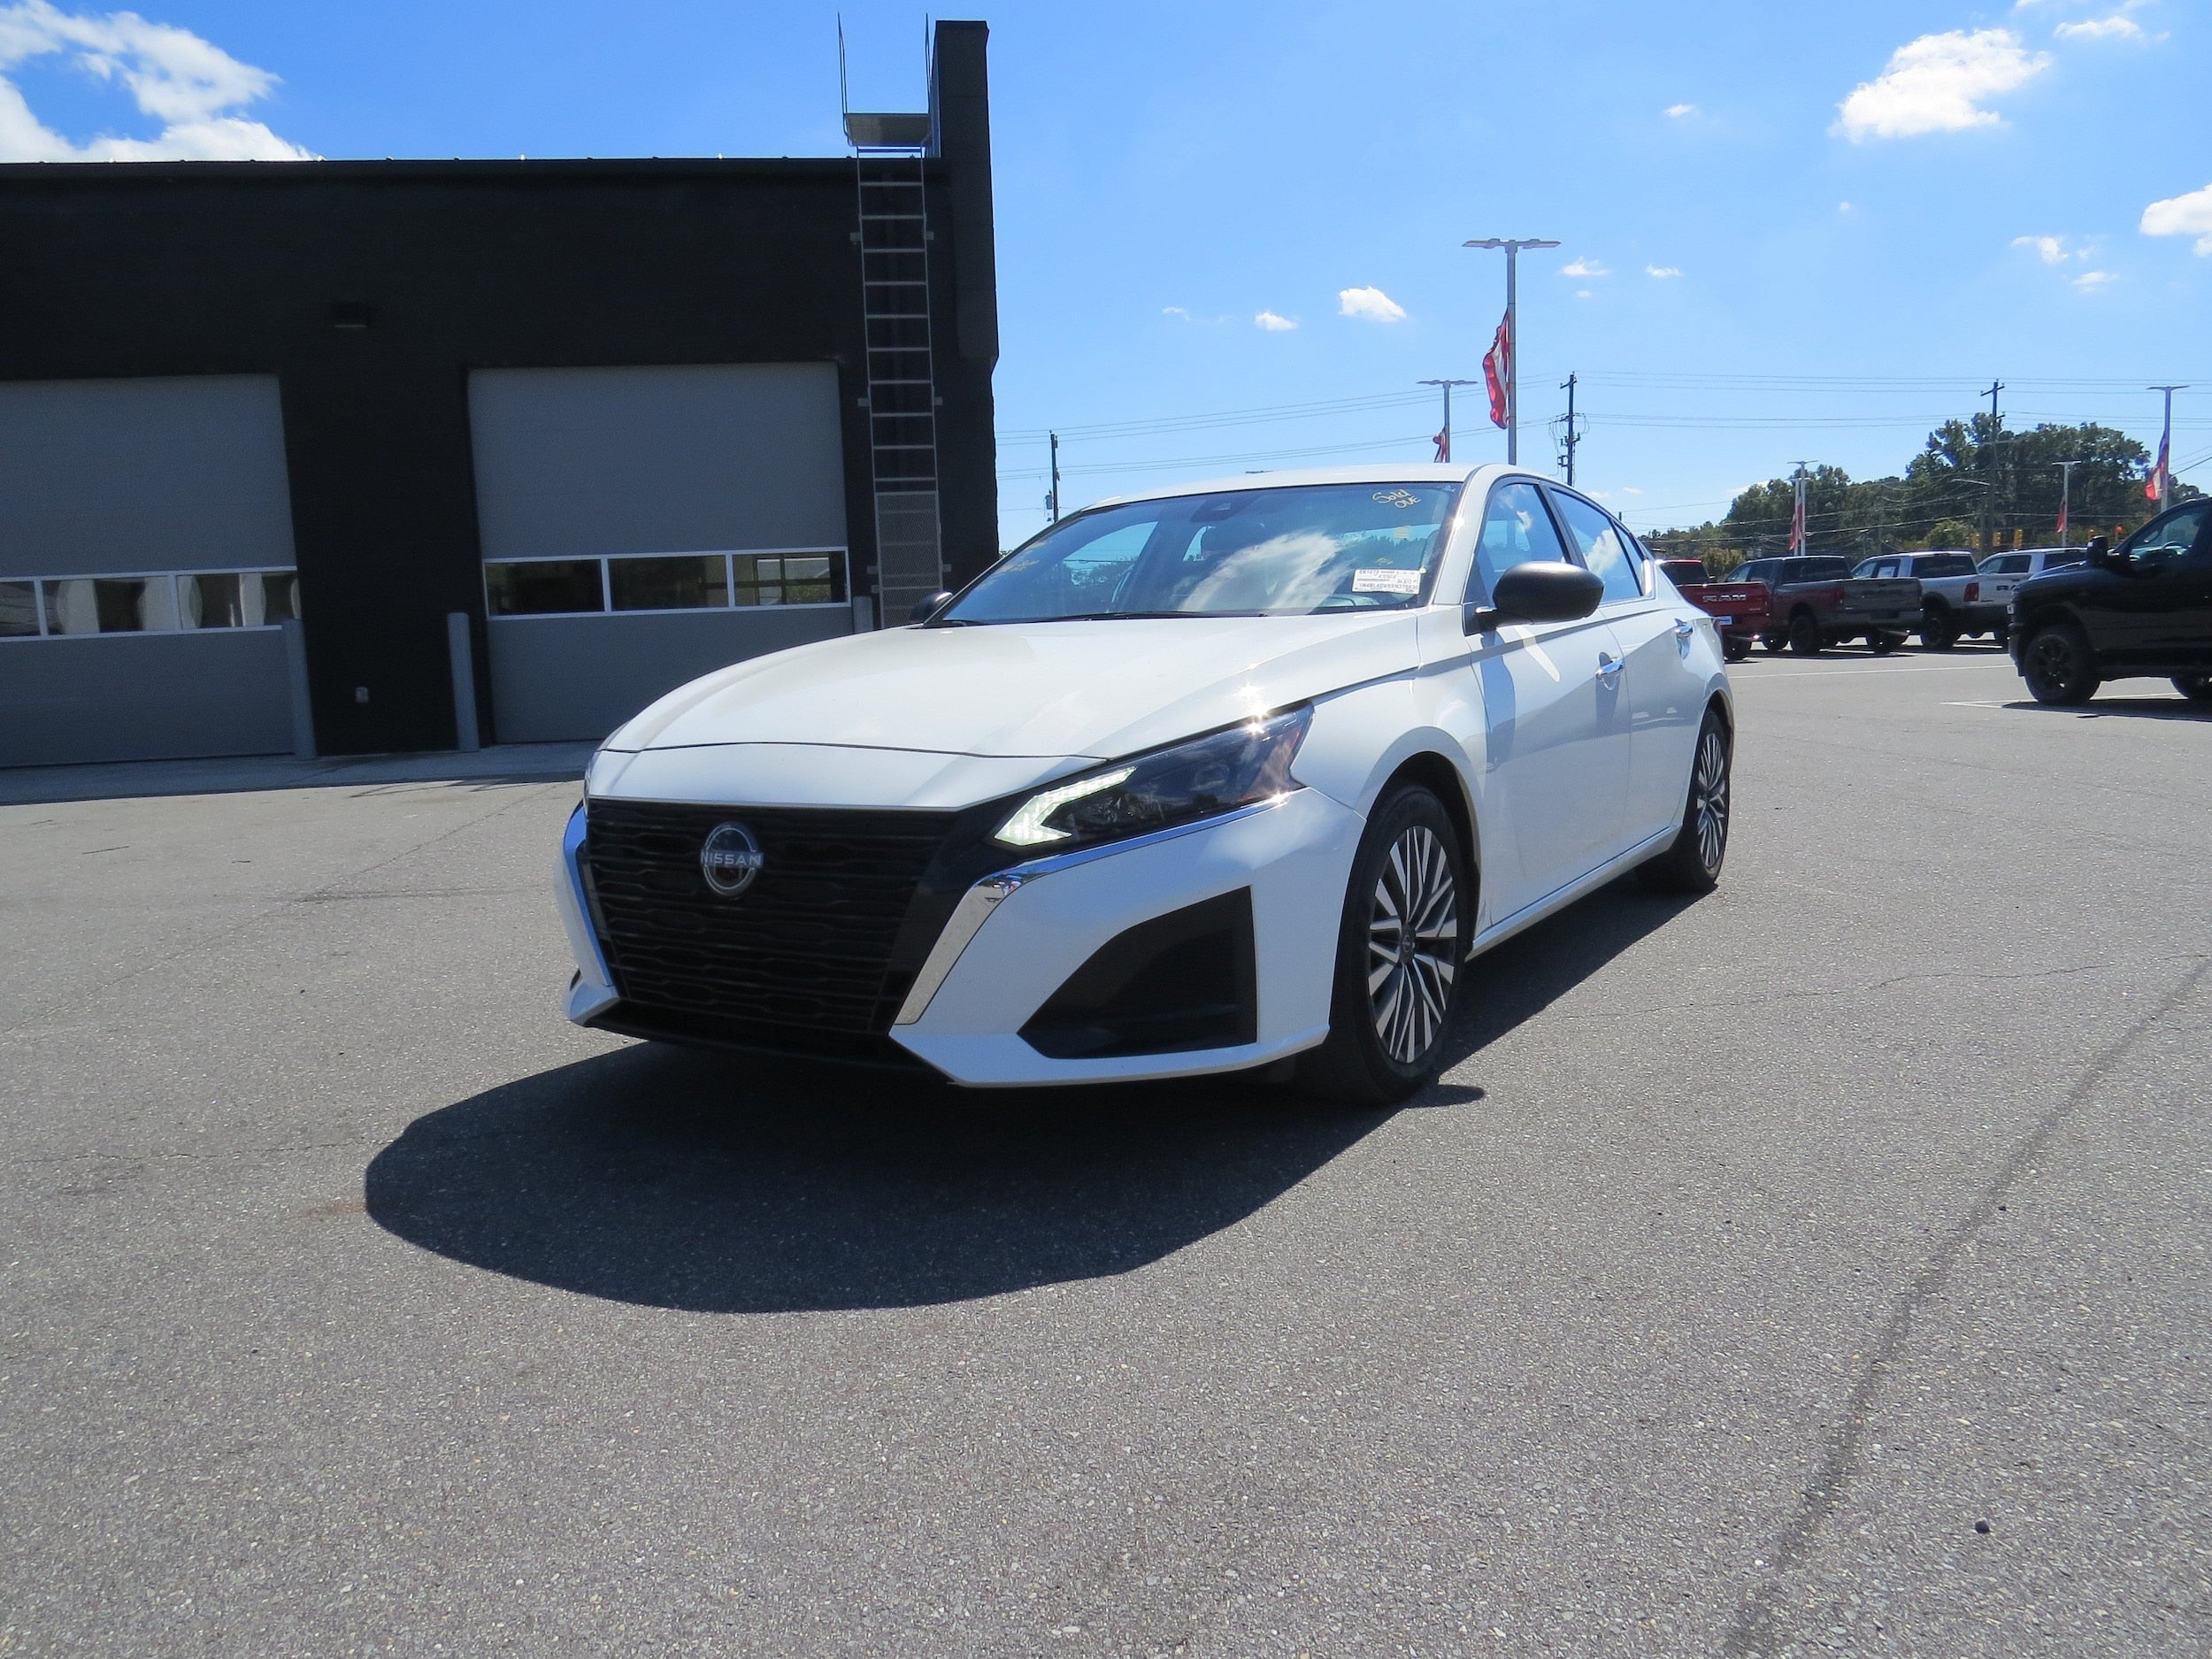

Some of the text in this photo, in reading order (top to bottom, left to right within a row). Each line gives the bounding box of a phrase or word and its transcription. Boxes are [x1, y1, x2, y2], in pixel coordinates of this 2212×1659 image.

[1372, 488, 1410, 503] Sold
[1702, 594, 1747, 603] RAM
[701, 850, 761, 866] NISSAN
